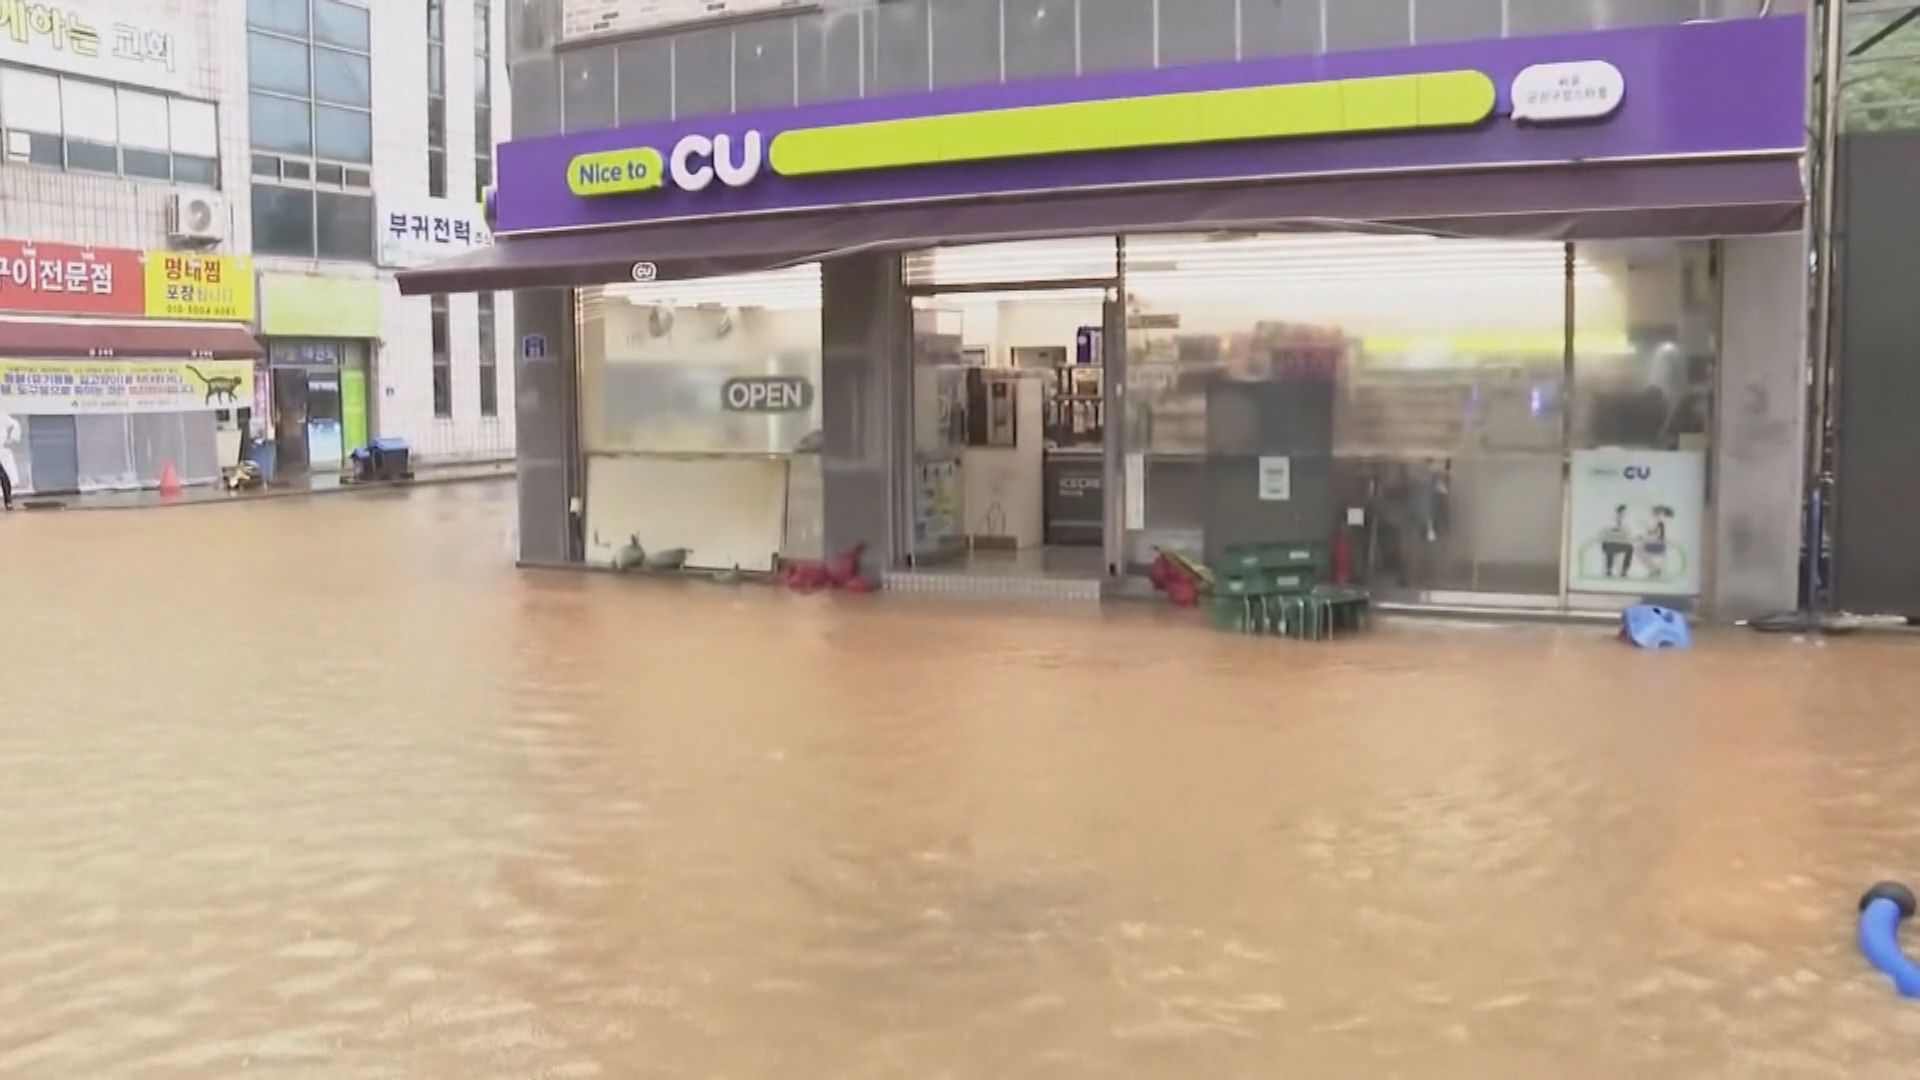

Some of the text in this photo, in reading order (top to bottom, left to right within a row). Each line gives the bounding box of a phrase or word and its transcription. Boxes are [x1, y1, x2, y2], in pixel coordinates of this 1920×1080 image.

[112, 22, 175, 73] 교회
[579, 130, 761, 192] Nice to CU
[389, 212, 471, 246] 부귀전력
[165, 256, 221, 284] 명태찜
[727, 382, 803, 409] OPEN
[1623, 465, 1651, 481] CU
